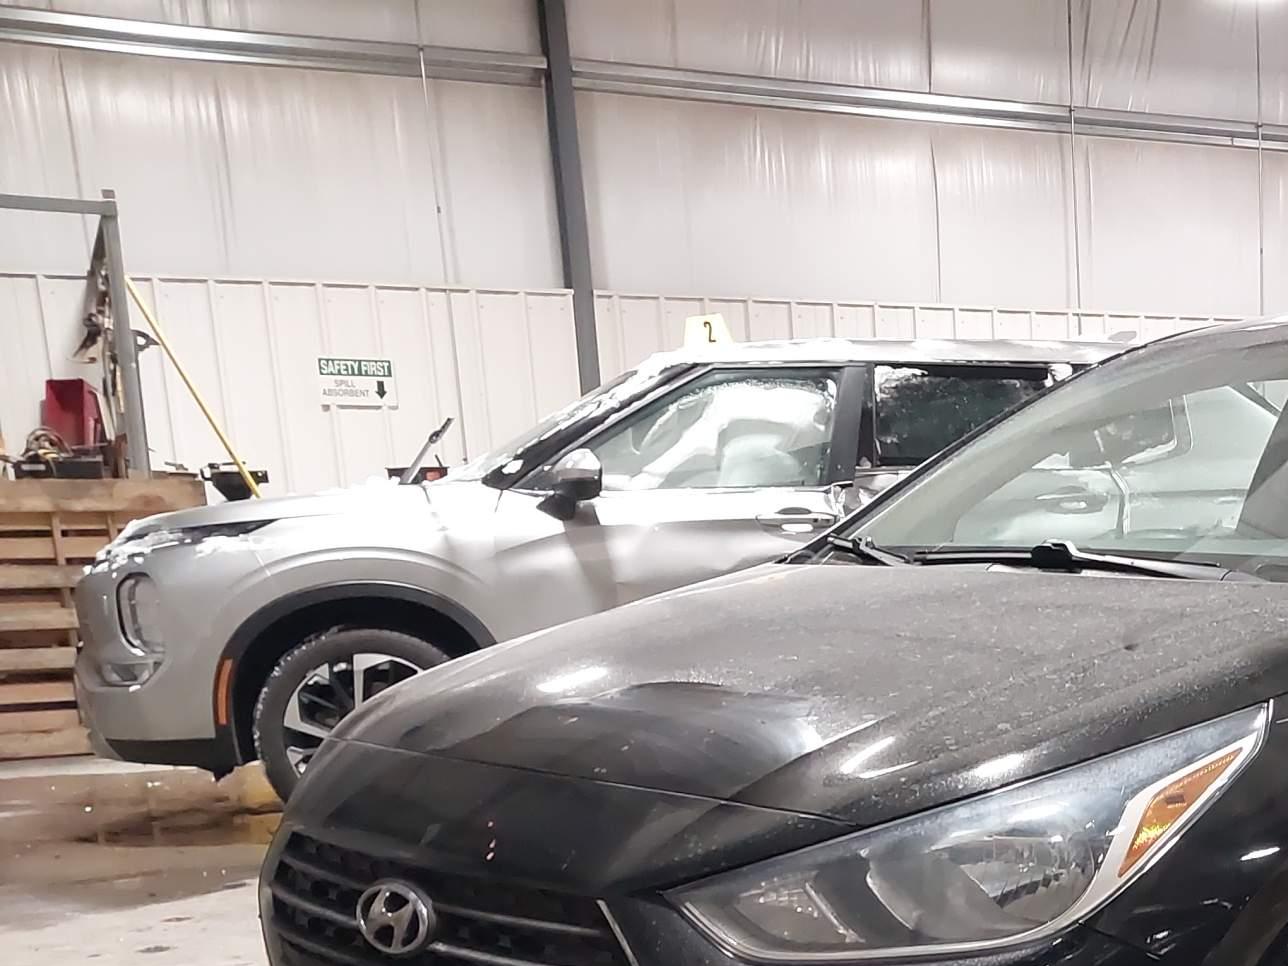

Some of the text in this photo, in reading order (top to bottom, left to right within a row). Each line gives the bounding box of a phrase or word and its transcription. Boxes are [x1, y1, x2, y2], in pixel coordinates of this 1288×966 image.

[703, 321, 717, 343] 2
[320, 360, 390, 376] SAFETY FIRST
[334, 379, 356, 388] SPILL
[322, 388, 369, 398] ABSORBENT
